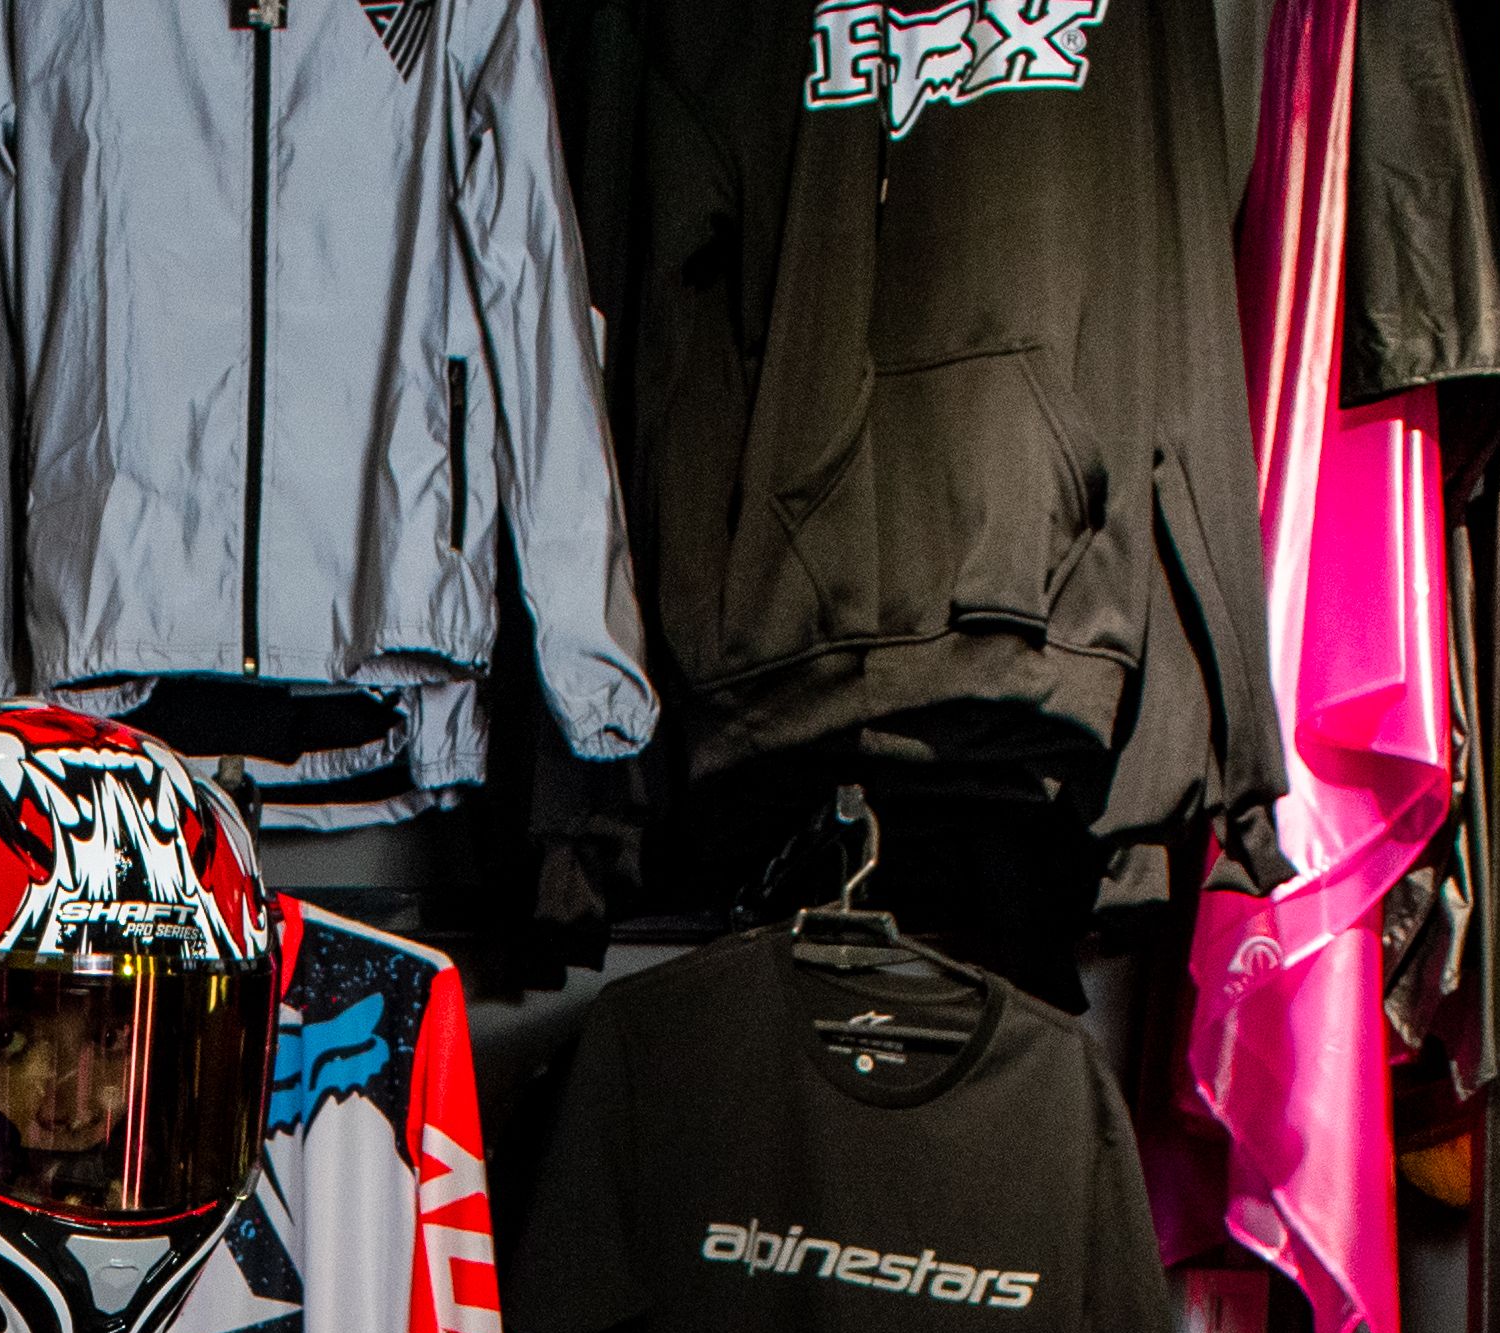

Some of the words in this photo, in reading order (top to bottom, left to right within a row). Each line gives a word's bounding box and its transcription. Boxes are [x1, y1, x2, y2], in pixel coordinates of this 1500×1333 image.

[58, 900, 197, 923] SHAFT
[126, 922, 154, 937] PRO
[155, 924, 199, 940] SERIES
[702, 1217, 1041, 1310] alpinestars
